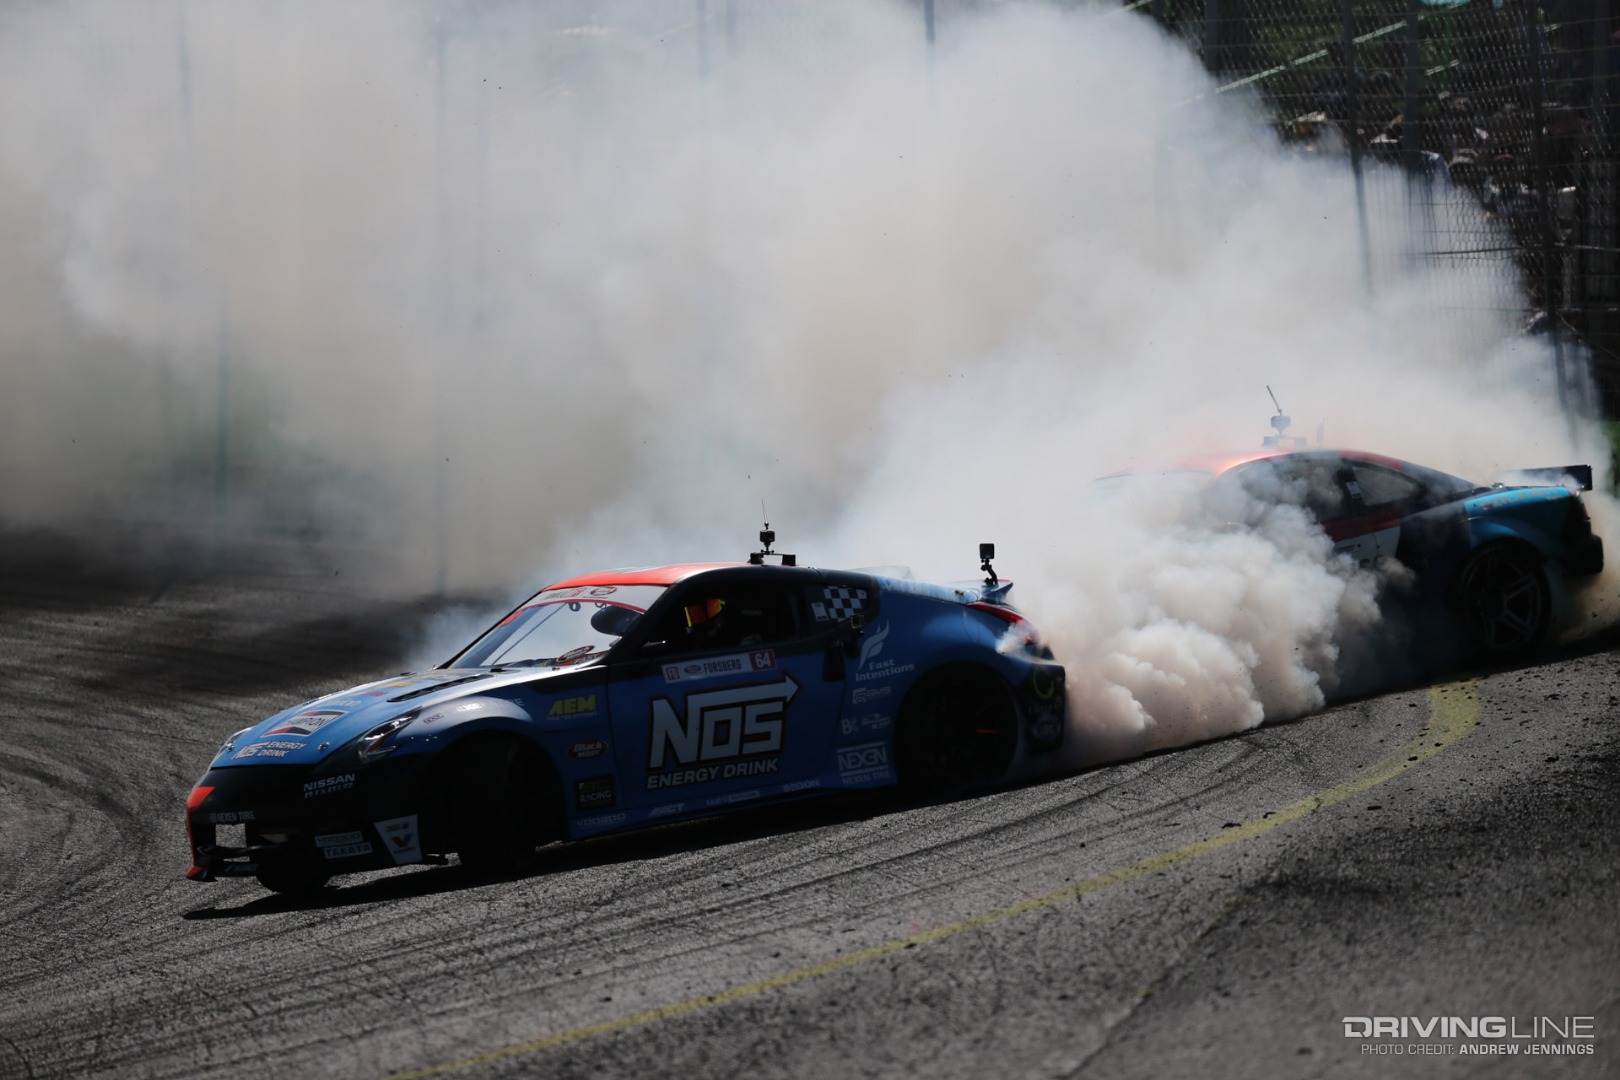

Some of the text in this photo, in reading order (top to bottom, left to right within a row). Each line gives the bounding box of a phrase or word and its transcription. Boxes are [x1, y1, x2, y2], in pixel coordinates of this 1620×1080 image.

[703, 658, 742, 674] FORSBERG
[754, 652, 771, 668] 64
[869, 658, 895, 670] Fast
[855, 663, 915, 681] Intentions
[548, 694, 596, 716] AEM
[648, 680, 801, 770] NOS
[267, 741, 308, 750] ENERGY
[256, 749, 289, 757] DRINK
[646, 758, 780, 790] ENERGY DRINK
[842, 774, 872, 786] NEXEN
[303, 772, 356, 793] NISSAN
[579, 790, 612, 803] RACING
[237, 810, 256, 821] TIRE
[325, 844, 371, 857] TAKATA
